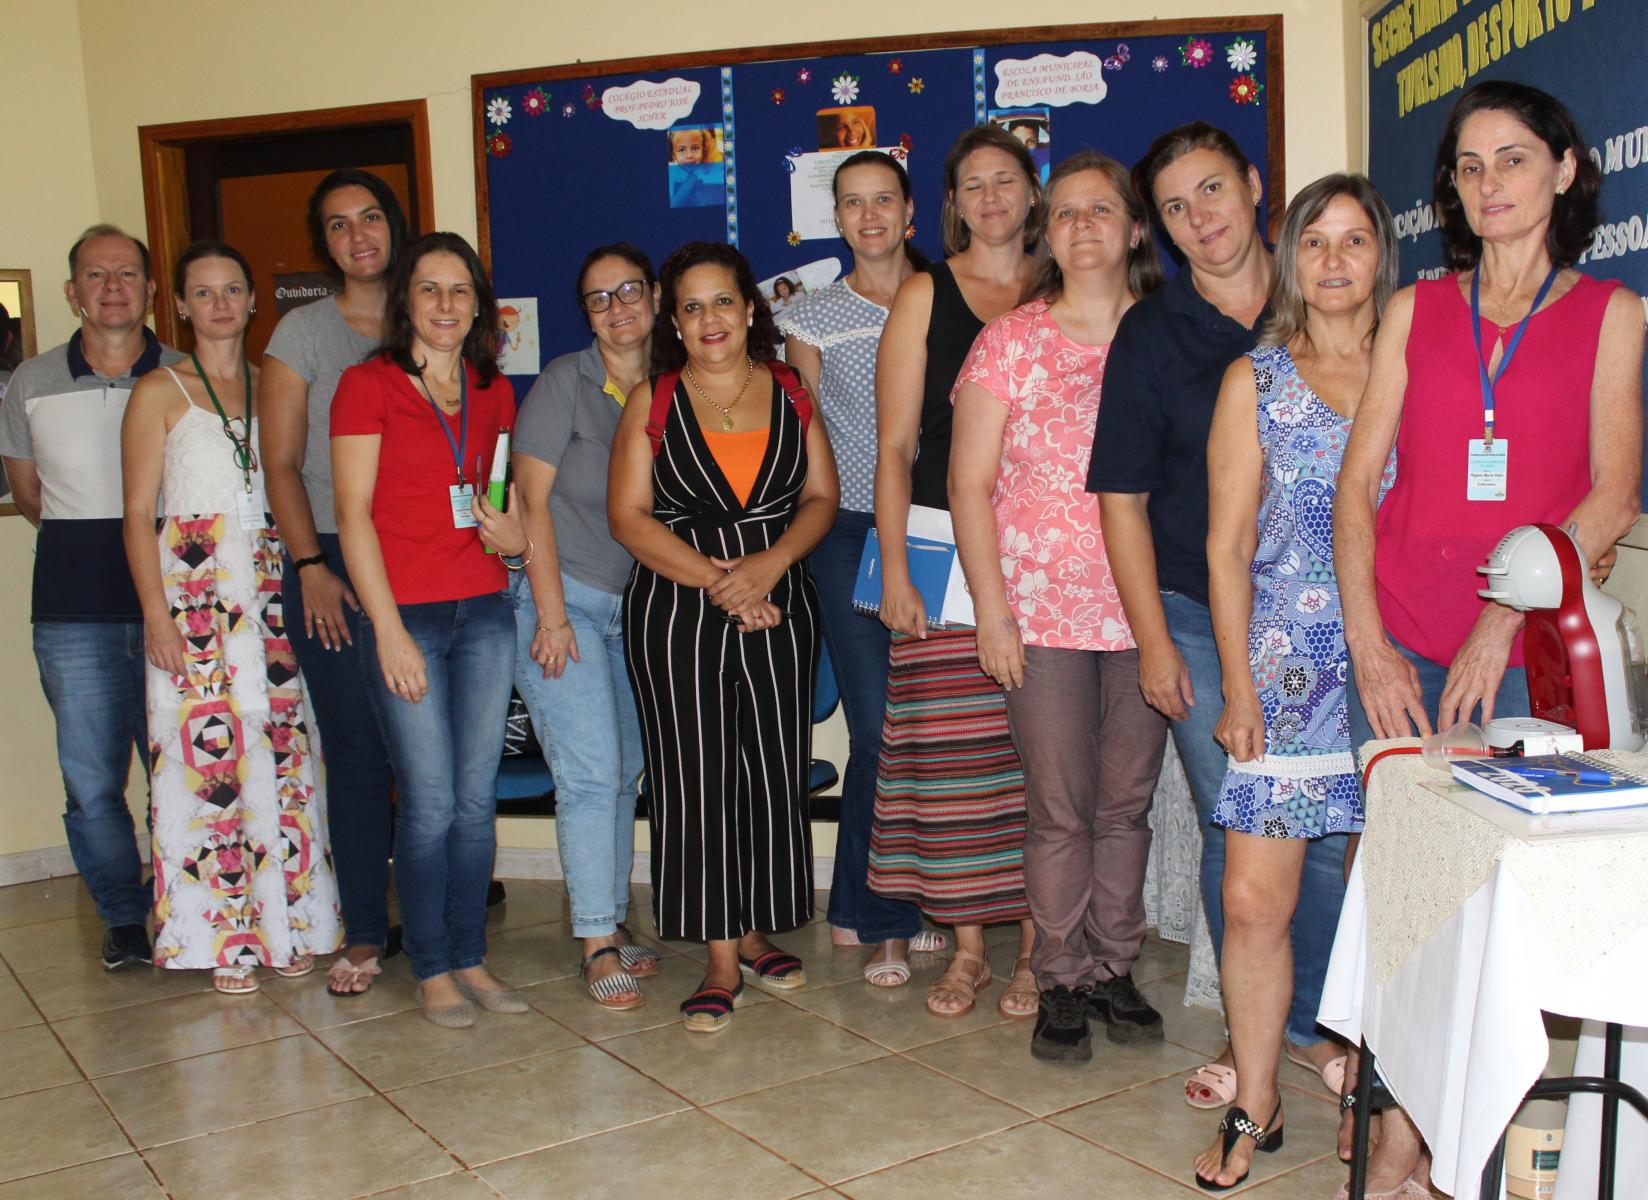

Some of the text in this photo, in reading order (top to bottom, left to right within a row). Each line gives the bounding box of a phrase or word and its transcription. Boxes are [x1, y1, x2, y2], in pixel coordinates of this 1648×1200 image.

[1003, 60, 1095, 76] ESCOLA MUNICIPAL
[1006, 79, 1020, 88] DE
[647, 86, 694, 98] ESTADUAL
[1001, 87, 1052, 100] FRANCISCO
[1054, 86, 1068, 95] DE
[275, 285, 328, 299] Ouvidoria
